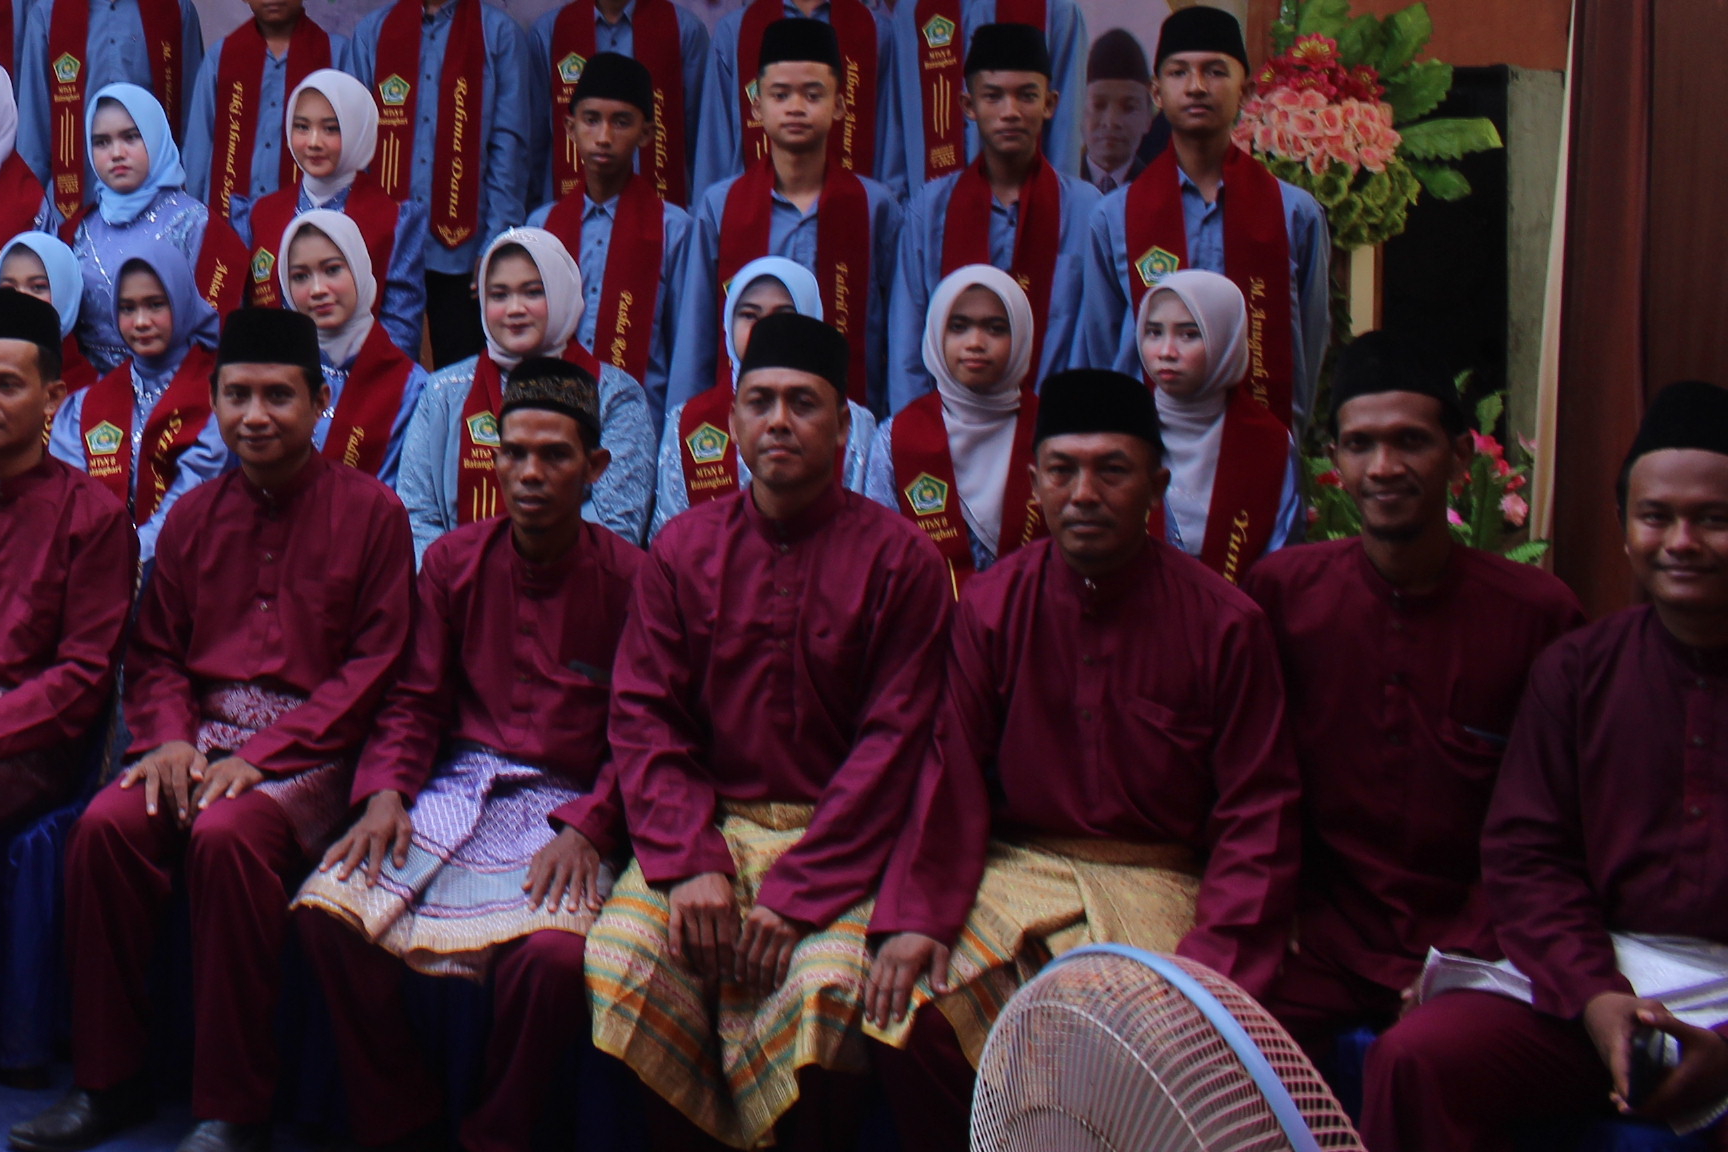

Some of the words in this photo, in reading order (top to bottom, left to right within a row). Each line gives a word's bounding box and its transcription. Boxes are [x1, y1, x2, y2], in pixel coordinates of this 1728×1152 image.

[226, 114, 241, 178] Ahmad
[453, 76, 468, 153] Rahma
[653, 87, 668, 169] Fadhila
[448, 156, 464, 219] Dana
[209, 256, 229, 298] Anisa
[616, 289, 633, 335] Pasha
[1248, 302, 1270, 378] Anugrah
